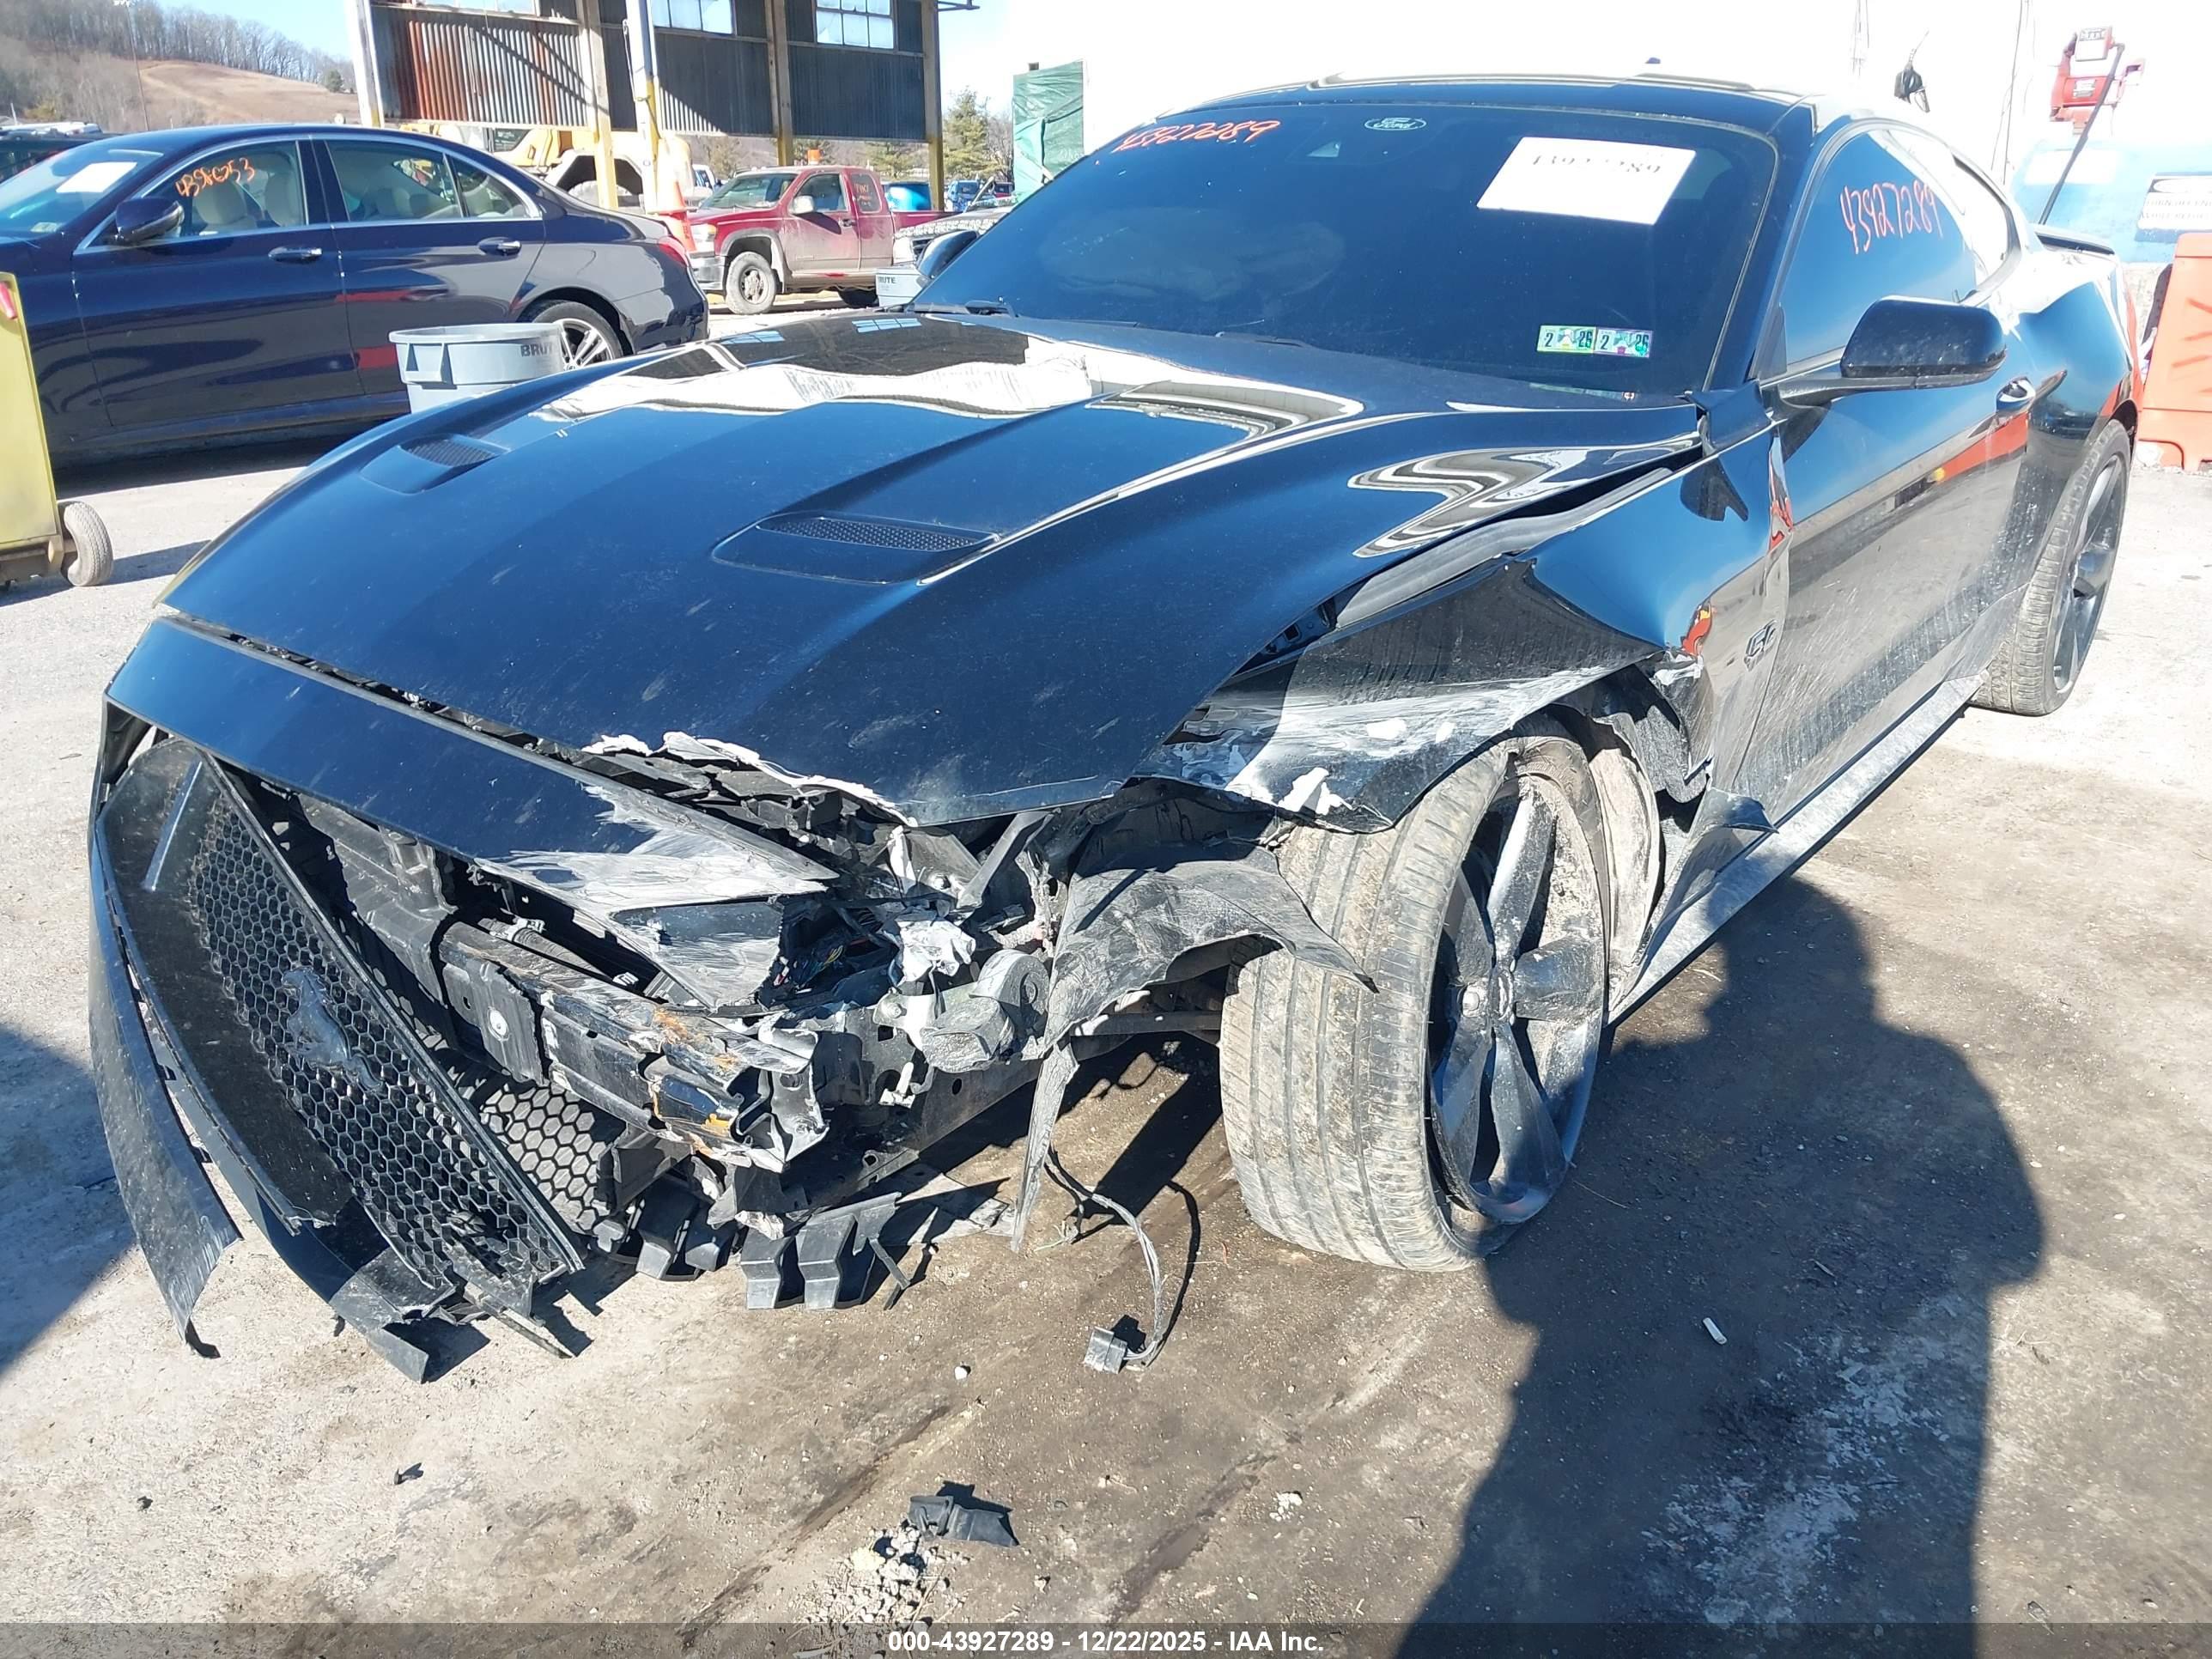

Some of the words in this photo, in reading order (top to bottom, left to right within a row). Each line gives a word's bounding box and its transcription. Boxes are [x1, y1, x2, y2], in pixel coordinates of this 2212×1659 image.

[1840, 179, 1943, 254] 43927289
[1545, 332, 1554, 348] 2
[1600, 334, 1610, 350] 2
